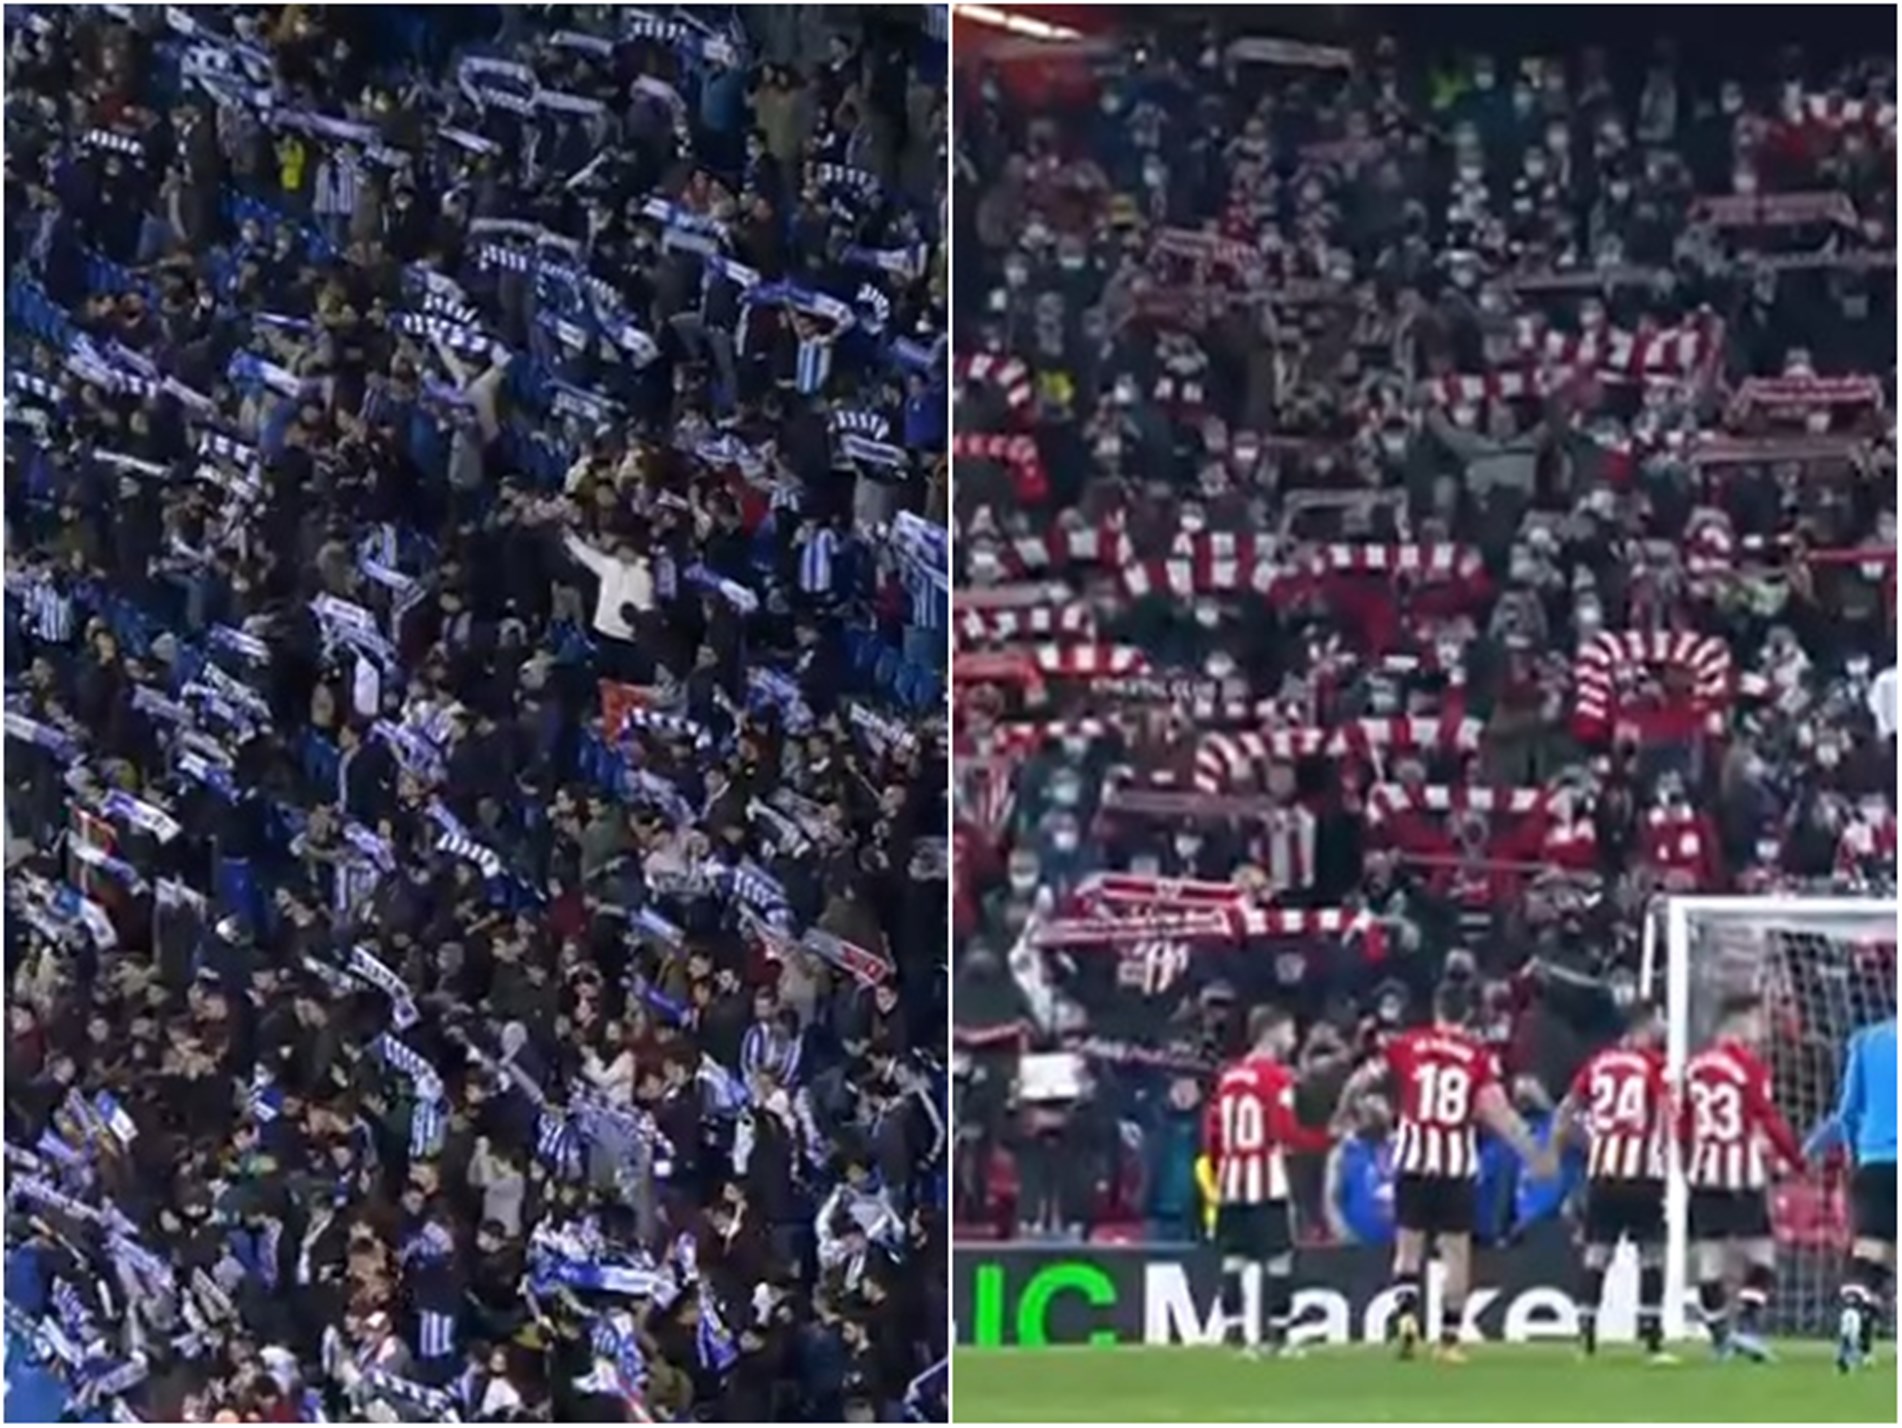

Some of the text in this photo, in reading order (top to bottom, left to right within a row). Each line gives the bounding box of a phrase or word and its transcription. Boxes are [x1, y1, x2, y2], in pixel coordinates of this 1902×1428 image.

[1220, 1092, 1264, 1154] 10
[1412, 1063, 1470, 1124] 18
[1591, 1075, 1645, 1132] 24
[1690, 1082, 1741, 1141] 33
[976, 1262, 1116, 1348] IC
